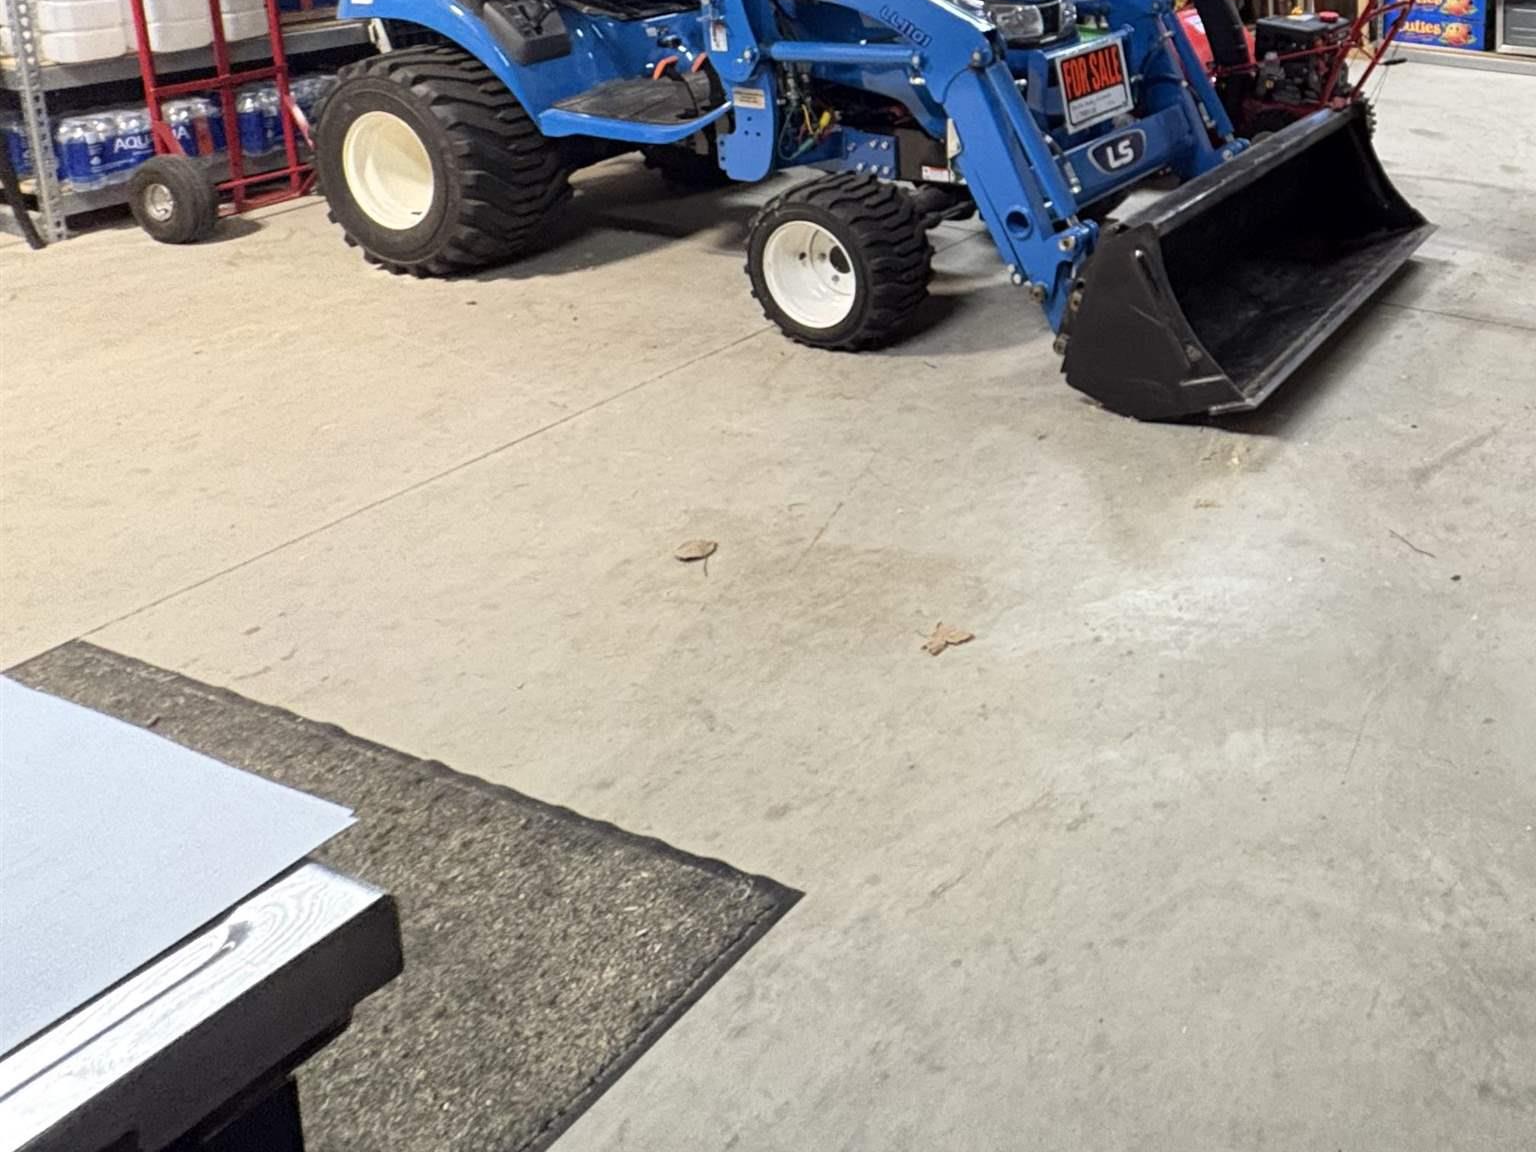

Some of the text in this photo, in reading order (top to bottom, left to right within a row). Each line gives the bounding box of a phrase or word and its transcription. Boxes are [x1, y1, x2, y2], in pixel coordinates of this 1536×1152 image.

[1399, 19, 1441, 36] uties
[1063, 47, 1122, 100] FOR SALE
[1106, 139, 1134, 168] LS
